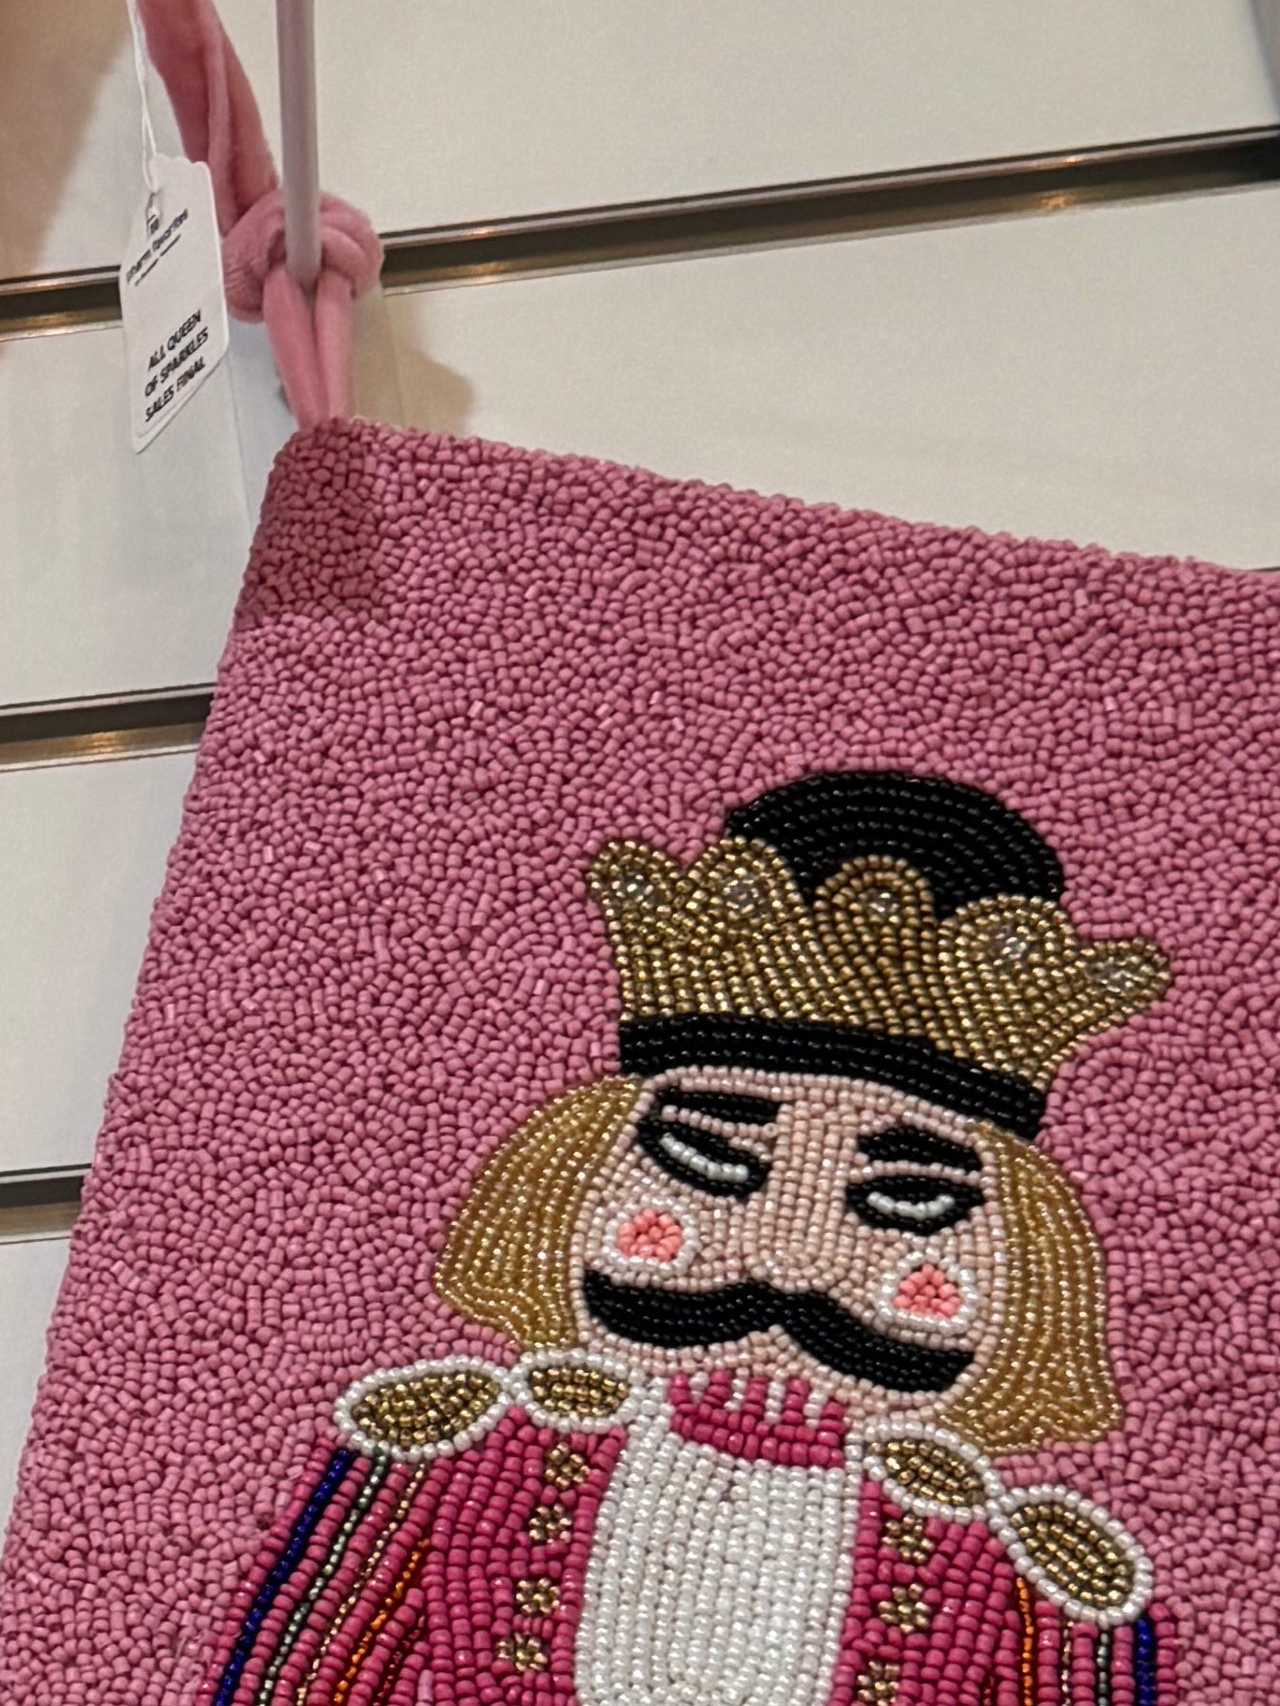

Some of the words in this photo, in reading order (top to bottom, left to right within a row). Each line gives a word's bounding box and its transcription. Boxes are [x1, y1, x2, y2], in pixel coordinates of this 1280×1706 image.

[145, 374, 158, 397] OF
[160, 326, 208, 384] SPARKLES
[148, 344, 166, 371] ALL
[167, 309, 201, 351] QUEEN
[145, 384, 175, 422] SALES
[177, 356, 206, 392] FINAL
